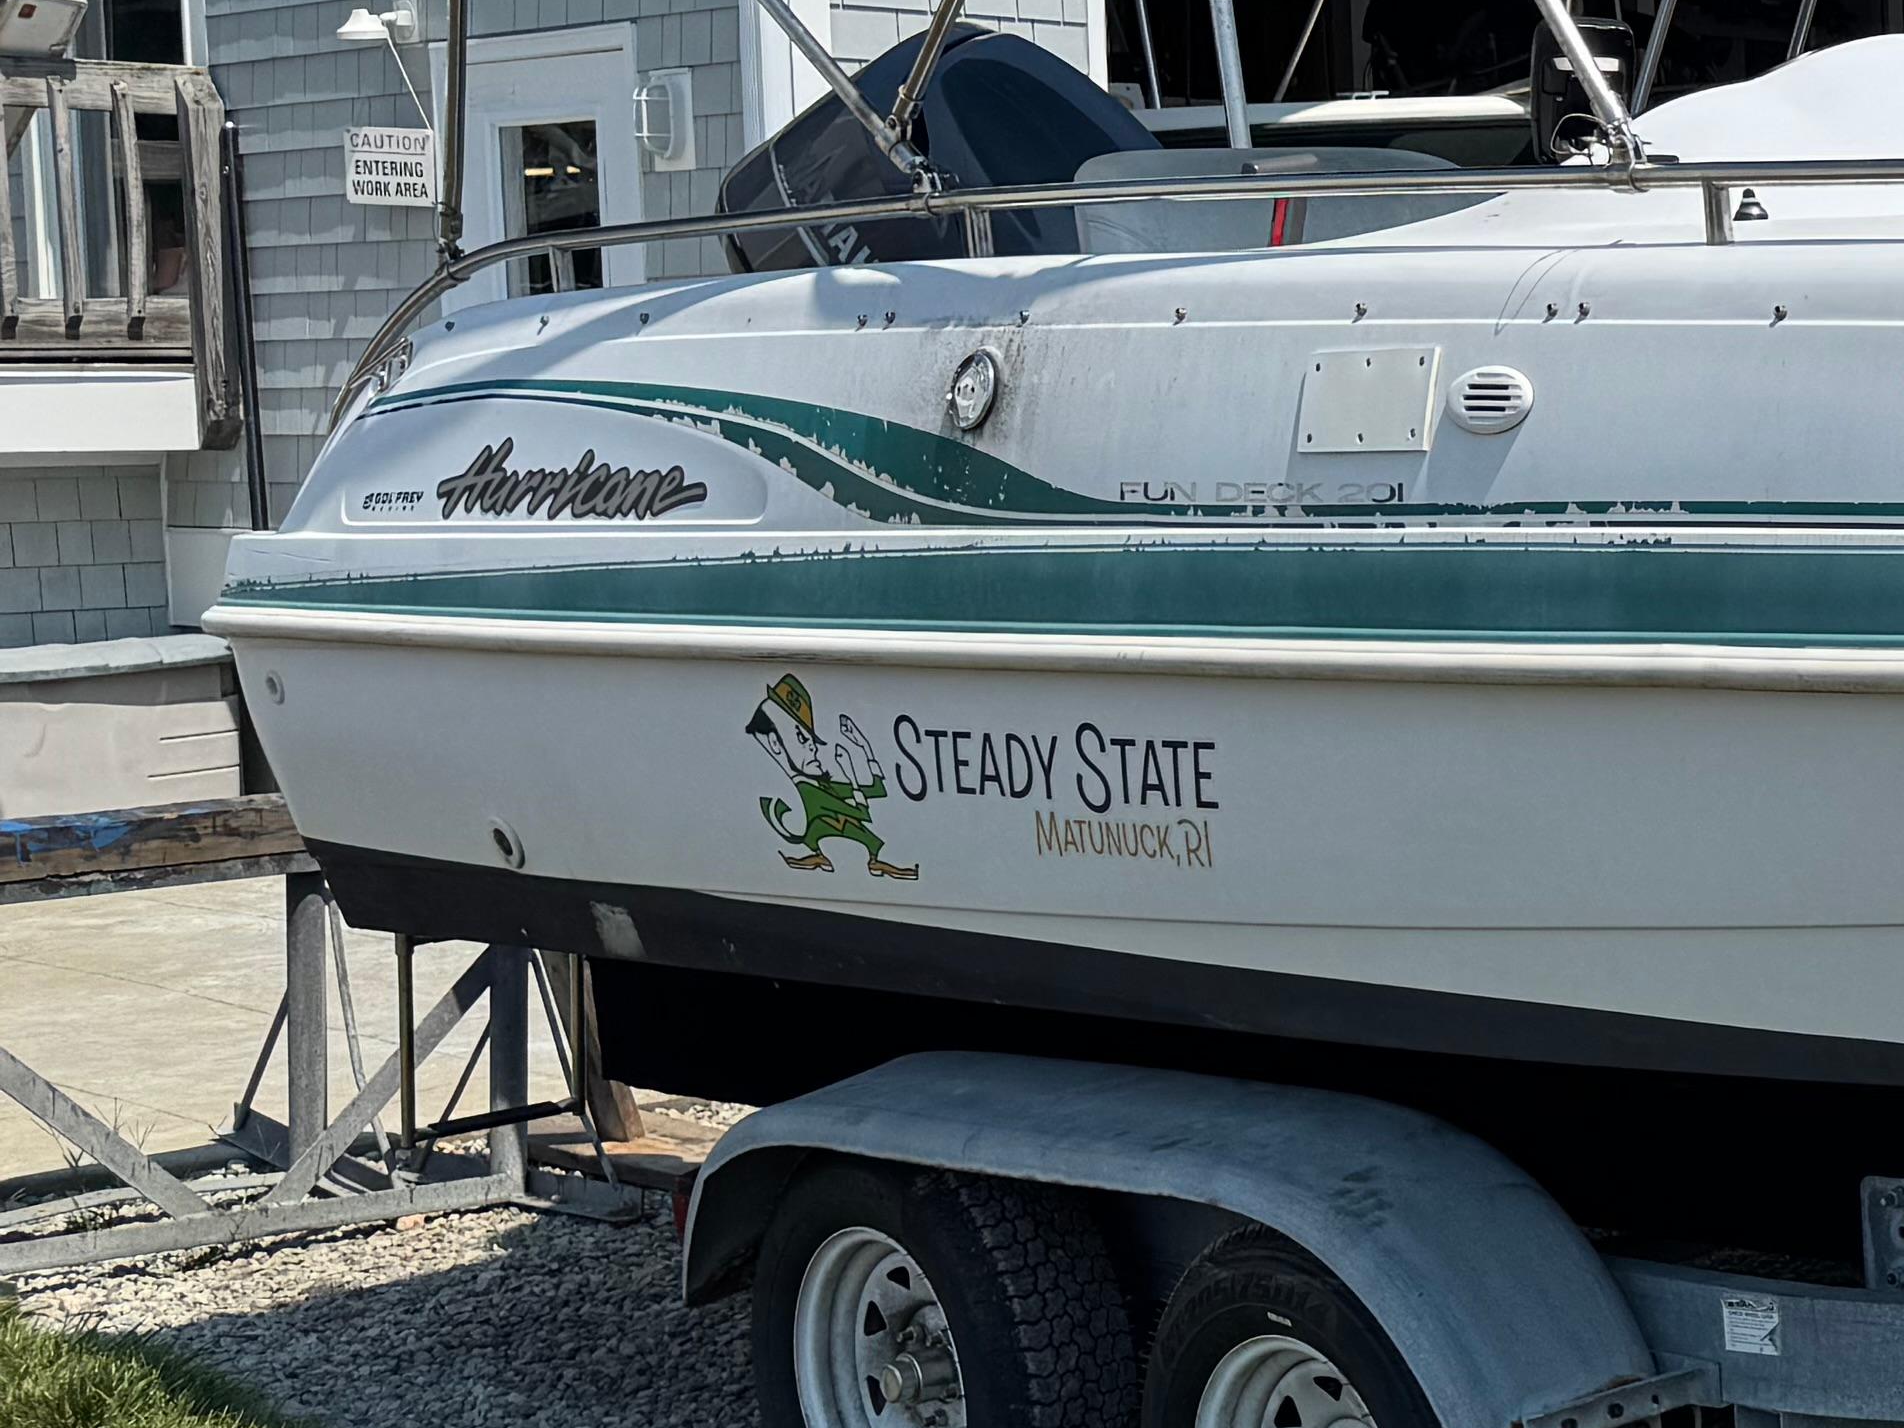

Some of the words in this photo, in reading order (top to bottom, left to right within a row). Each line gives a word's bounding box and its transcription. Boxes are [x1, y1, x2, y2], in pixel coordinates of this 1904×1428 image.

[350, 133, 426, 151] CAUTION
[355, 159, 424, 178] ENTERING
[352, 179, 392, 198] WORK
[395, 181, 429, 199] AREA
[437, 436, 707, 521] Hurricane
[1119, 481, 1197, 503] FUN
[1215, 482, 1324, 503] DECK
[893, 714, 1058, 803] STEADY
[1075, 722, 1220, 814] STATE
